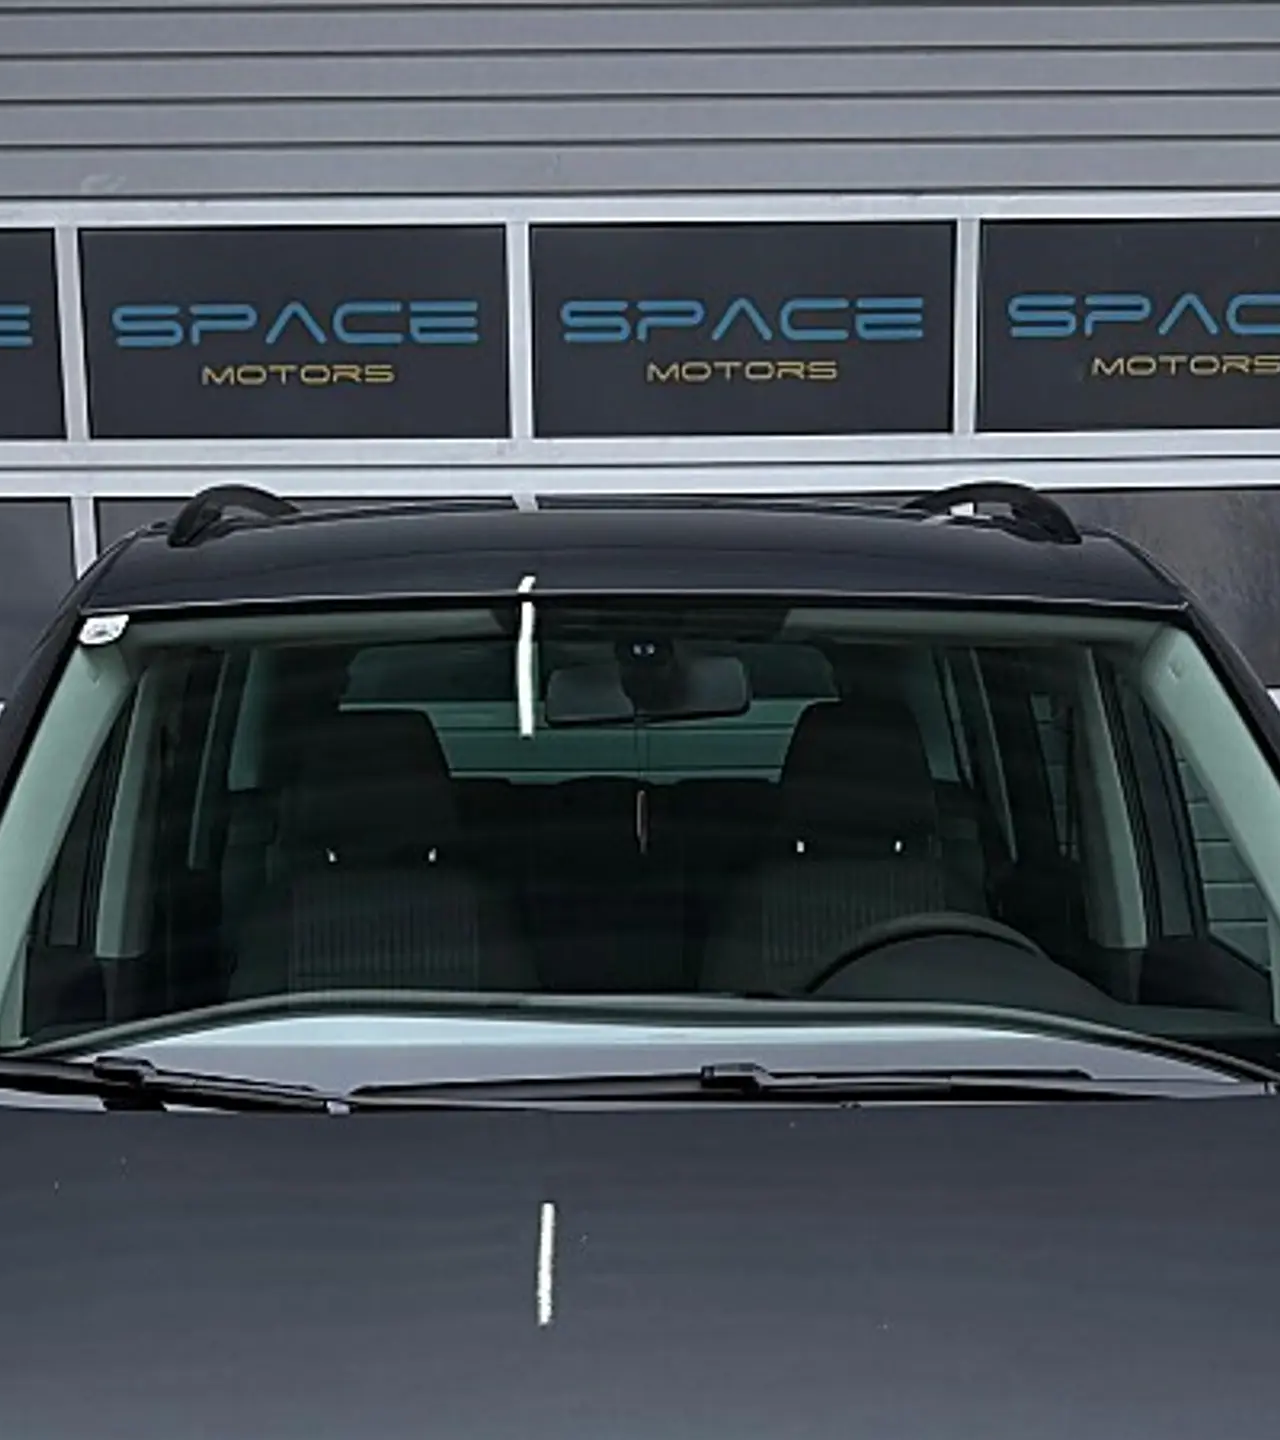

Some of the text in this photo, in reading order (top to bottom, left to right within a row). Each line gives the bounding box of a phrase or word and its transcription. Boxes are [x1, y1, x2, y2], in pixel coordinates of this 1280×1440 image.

[111, 299, 481, 348] SPACE
[560, 296, 925, 344] SPACE
[201, 364, 396, 385] MOTORS
[646, 360, 838, 382] MOTORS
